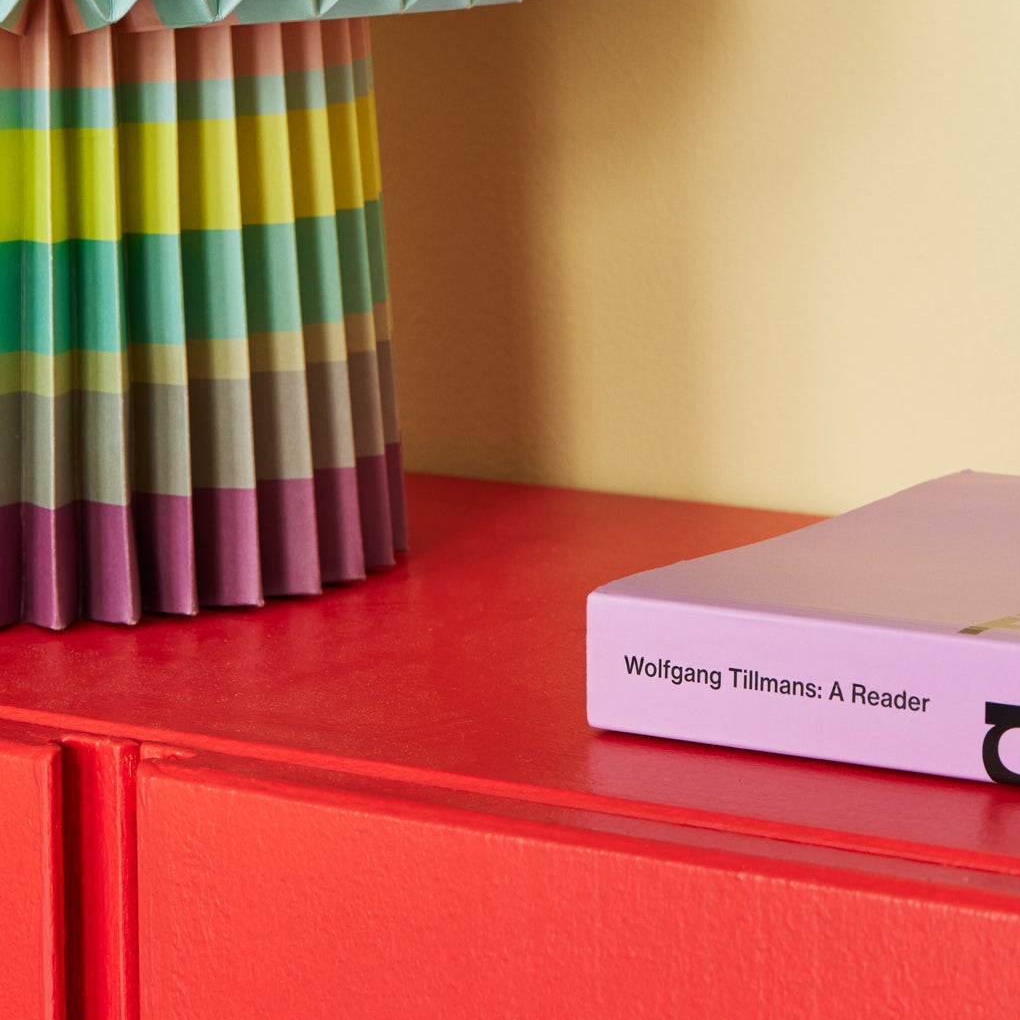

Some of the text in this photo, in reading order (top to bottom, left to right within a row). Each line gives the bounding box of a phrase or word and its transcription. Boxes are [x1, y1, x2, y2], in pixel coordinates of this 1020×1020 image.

[623, 655, 931, 713] Wolfgang Tillmans: A Reader
